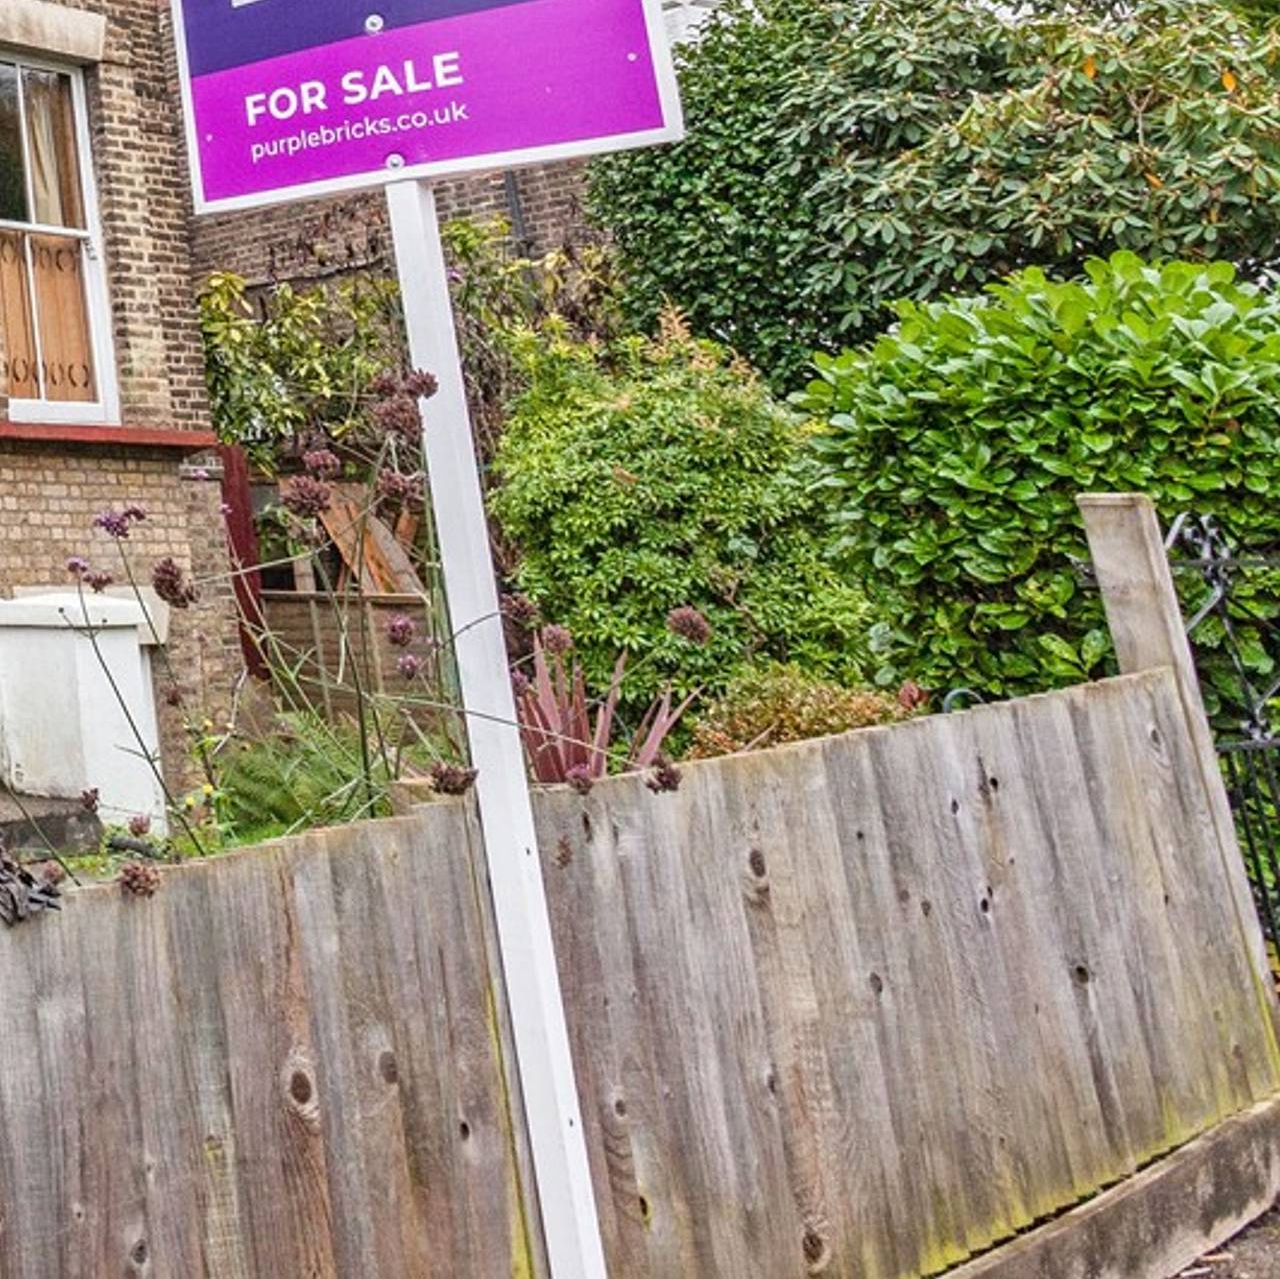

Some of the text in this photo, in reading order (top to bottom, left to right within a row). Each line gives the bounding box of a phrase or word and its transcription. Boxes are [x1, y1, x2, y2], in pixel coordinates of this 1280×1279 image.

[244, 51, 464, 126] FOR SALE
[250, 100, 469, 164] purplebricks.co.uk
